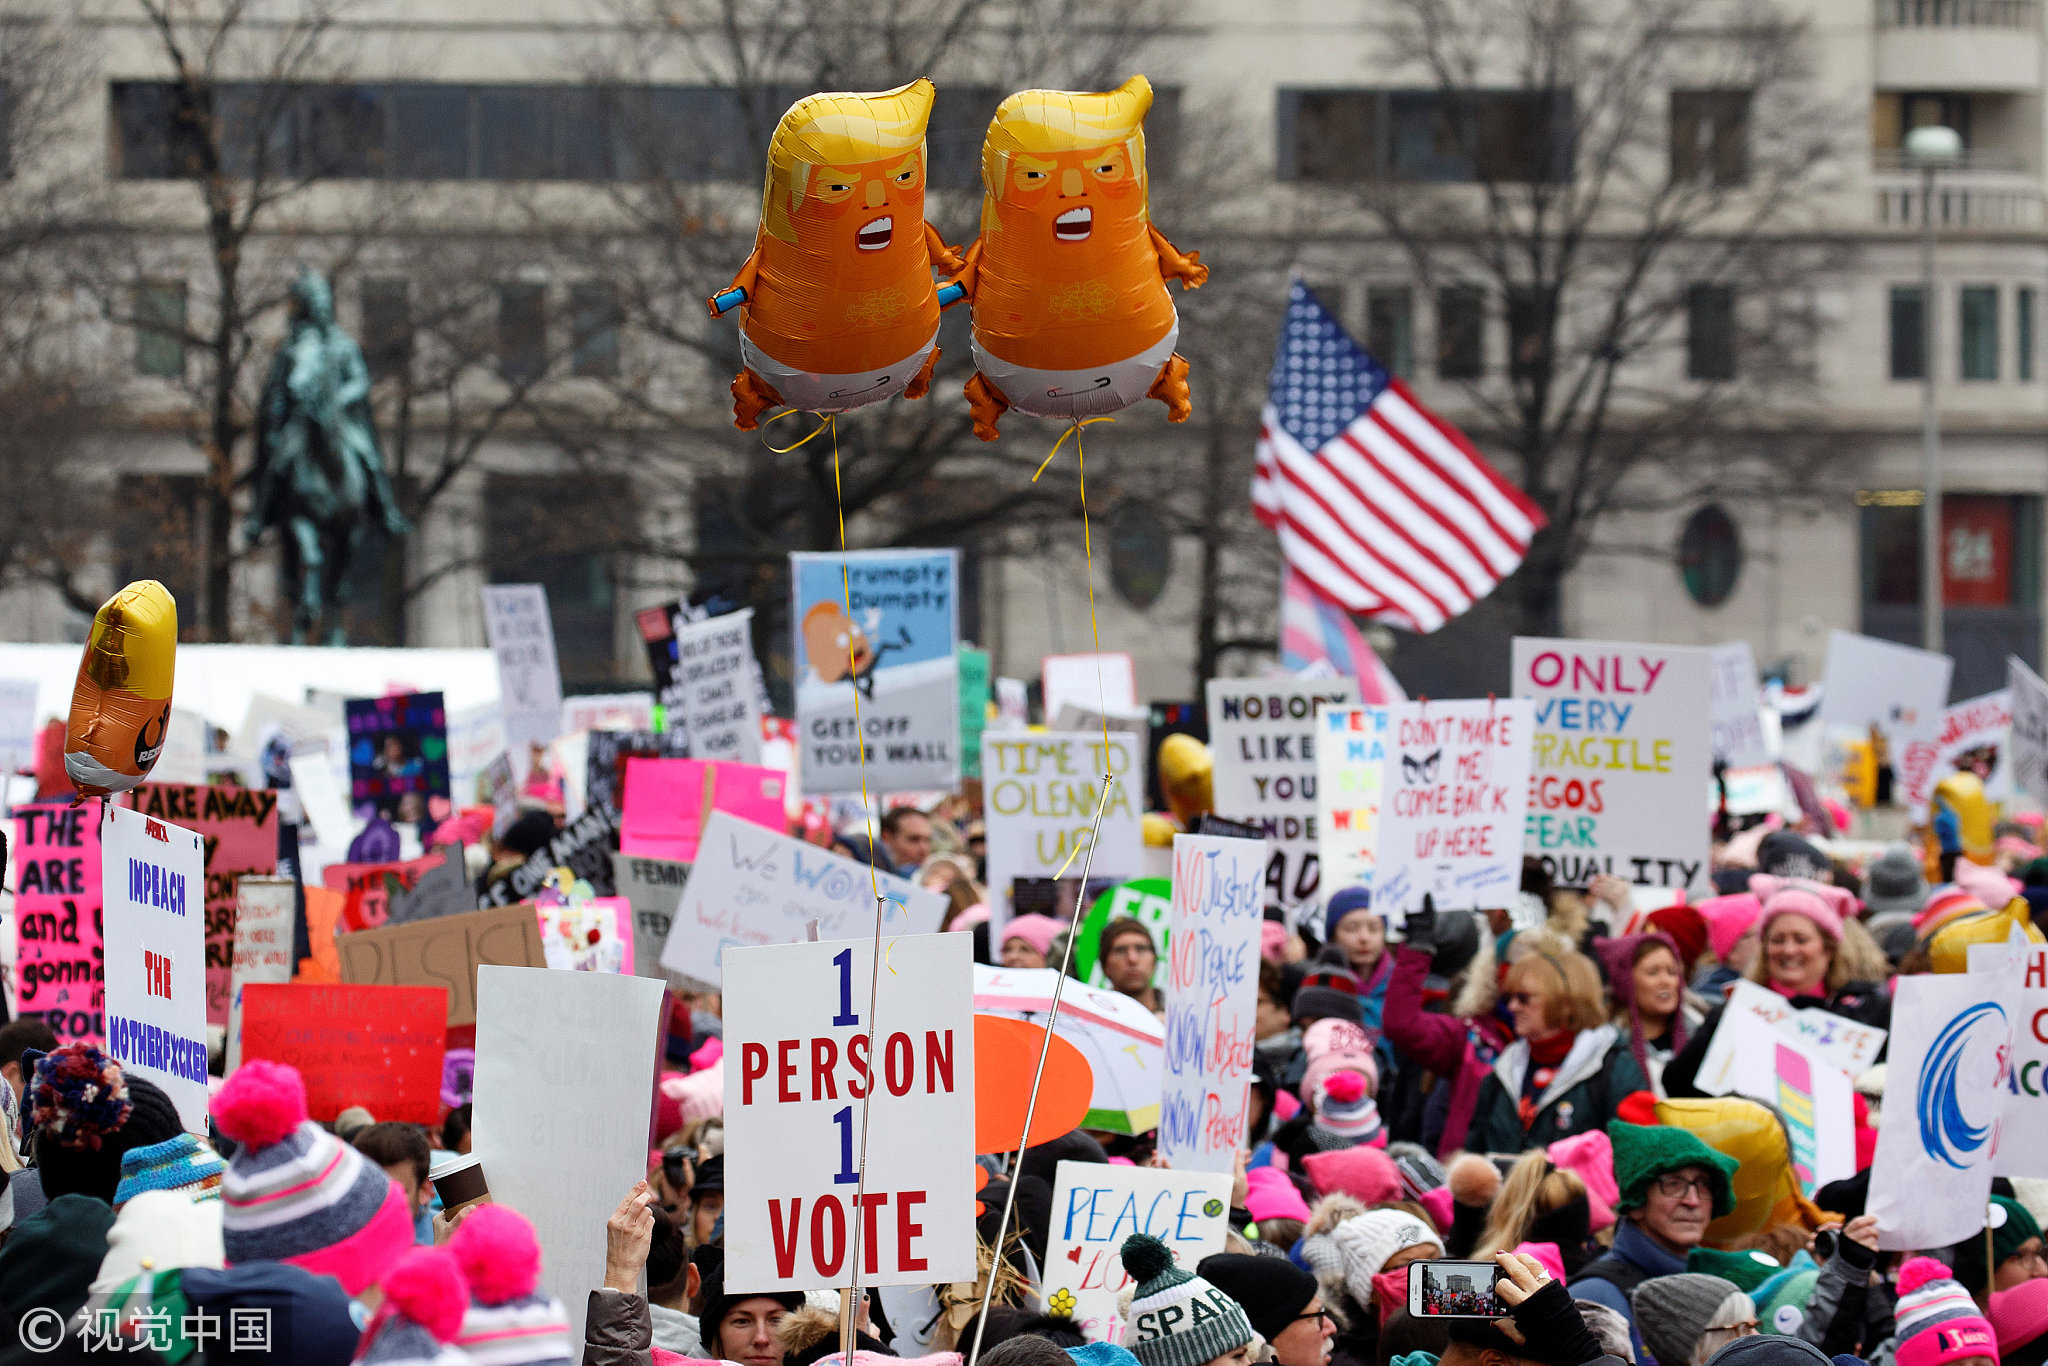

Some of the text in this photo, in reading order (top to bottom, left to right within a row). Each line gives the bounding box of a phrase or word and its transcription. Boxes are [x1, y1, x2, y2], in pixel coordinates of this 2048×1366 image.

[850, 590, 947, 612] Dumpty
[1529, 650, 1667, 696] ONLY
[811, 716, 911, 738] GET OFF
[1222, 694, 1347, 722] NOBO
[1458, 713, 1514, 746] MAKE
[812, 741, 947, 766] YOUR WALL
[989, 740, 1131, 777] TIME TO
[1454, 750, 1483, 781] ME
[127, 786, 278, 827] TAKE AWAY
[1253, 776, 1317, 801] YOU
[1393, 784, 1509, 818] COME BACK
[15, 809, 88, 848] THE
[1036, 825, 1095, 866] UP
[1415, 824, 1494, 859] UP HERE
[18, 857, 85, 896] ARE
[729, 832, 780, 882] We
[1541, 853, 1702, 889] QUALITY
[128, 856, 186, 918] IMPEACH
[1173, 845, 1204, 920] NO
[20, 900, 80, 944] and
[144, 949, 173, 1001] THE
[1169, 929, 1196, 993] NO
[832, 947, 860, 1027] 1
[1165, 983, 1219, 1078] KNOW
[741, 1028, 955, 1106] PERSON
[1161, 1087, 1207, 1157] KNOW
[832, 1105, 861, 1185] 1
[767, 1190, 929, 1280] VOTE
[1062, 1186, 1208, 1243] PEACE
[1078, 1248, 1182, 1294] LO
